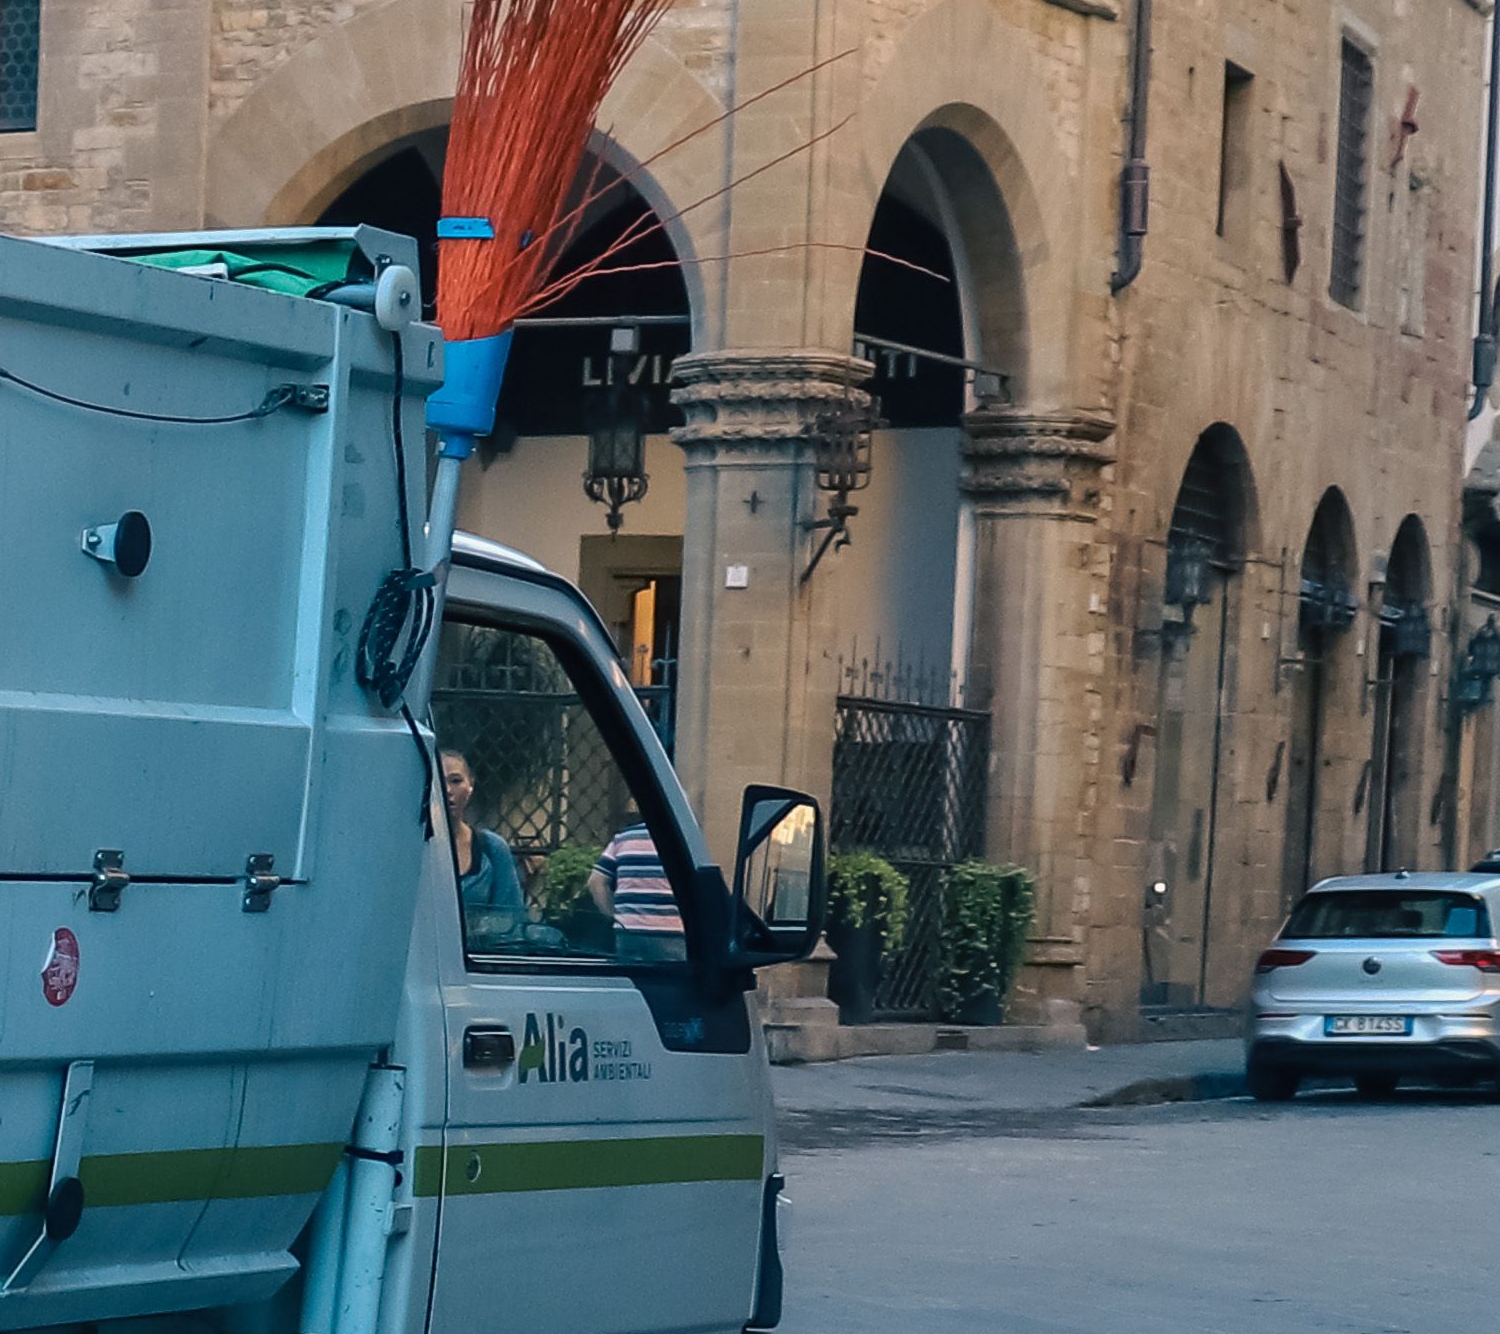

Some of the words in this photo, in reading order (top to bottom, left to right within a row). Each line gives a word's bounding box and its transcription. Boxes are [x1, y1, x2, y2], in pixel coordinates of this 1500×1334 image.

[518, 1012, 589, 1084] Alia
[593, 1041, 632, 1058] SERVIZI
[593, 1062, 651, 1080] AMBIENTALI
